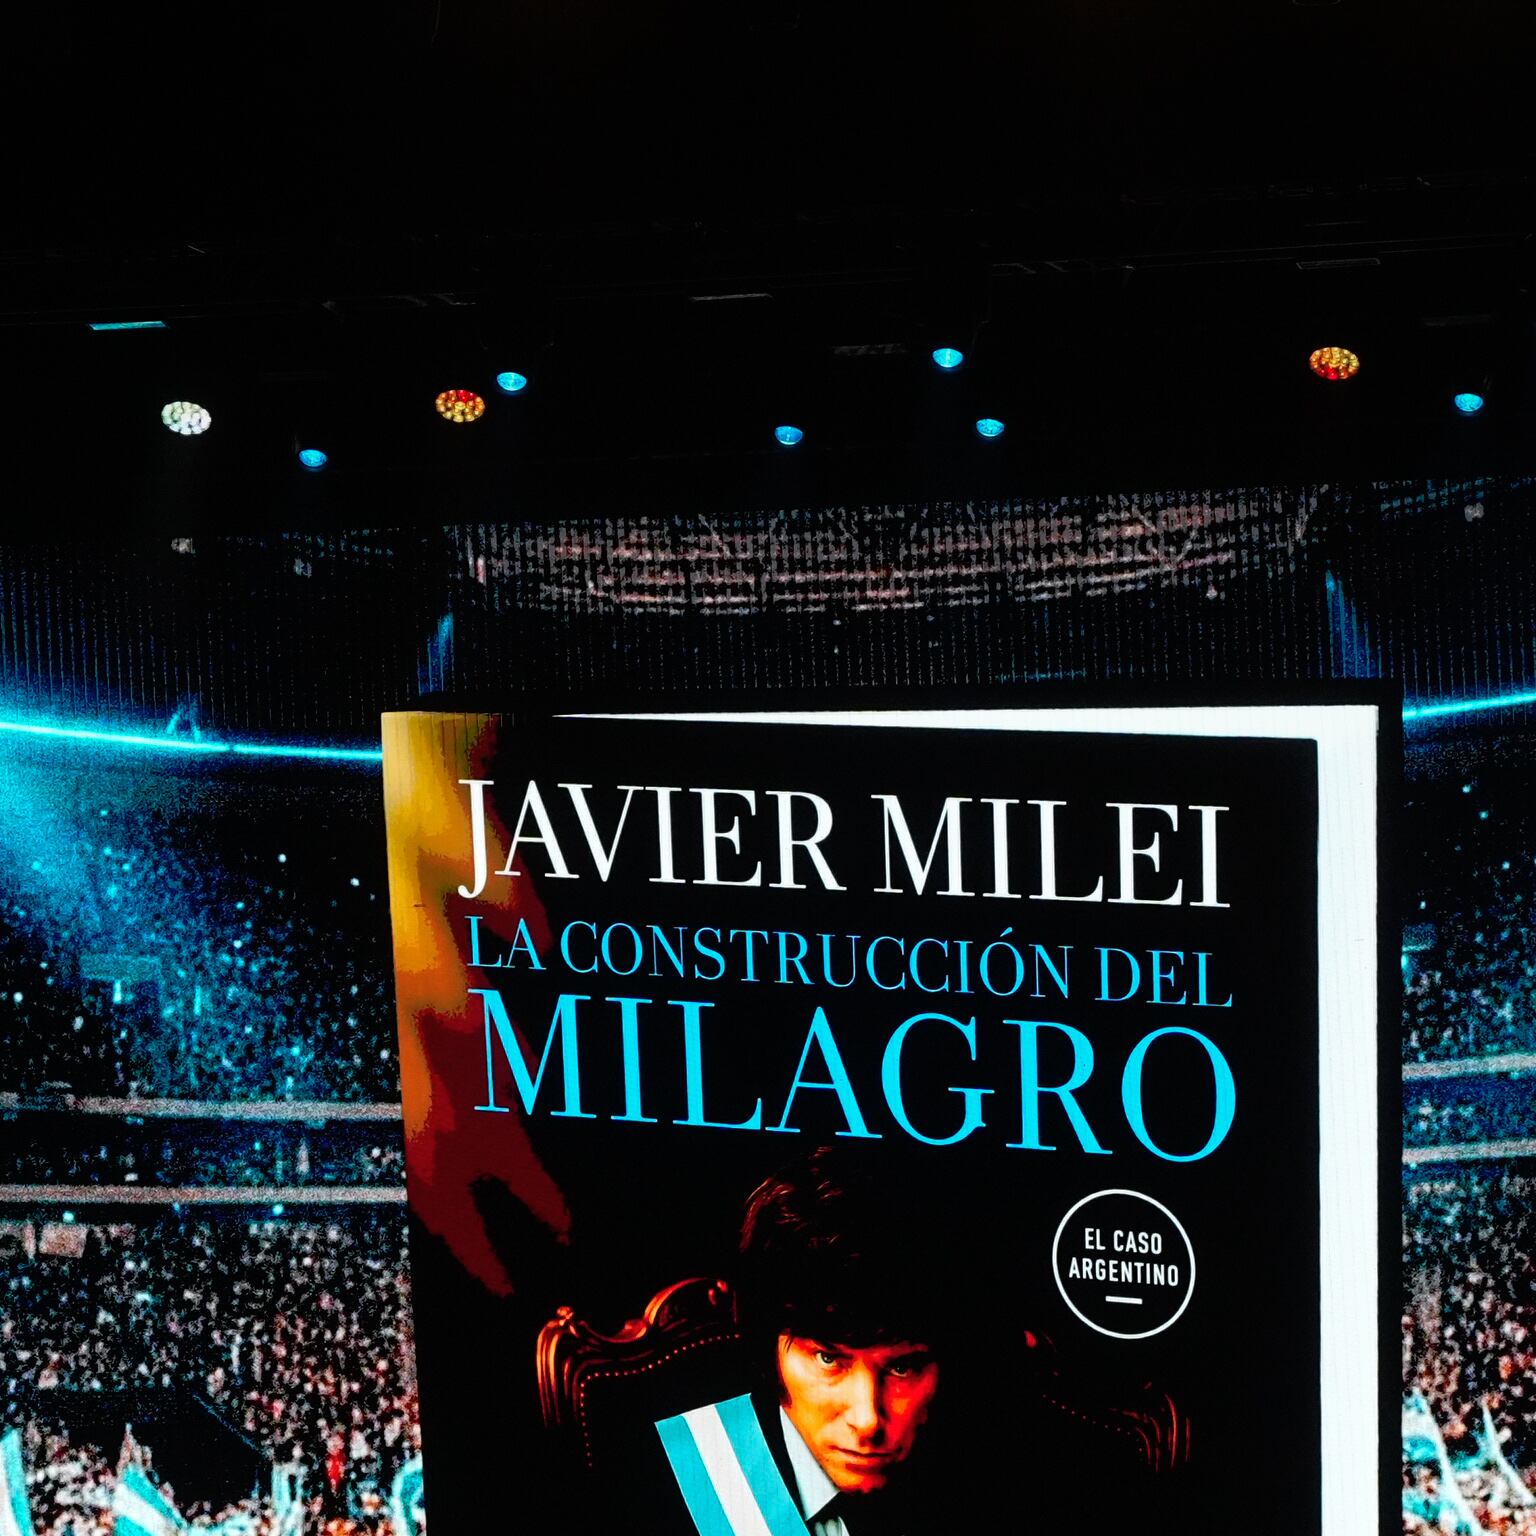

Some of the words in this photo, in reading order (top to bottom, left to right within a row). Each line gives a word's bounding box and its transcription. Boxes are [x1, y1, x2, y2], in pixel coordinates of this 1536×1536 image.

[457, 778, 849, 899] JAVIER
[870, 794, 1231, 908] MILEI
[464, 915, 546, 971] LA
[560, 920, 1074, 999] CONSTRUCCIÓN
[1094, 947, 1234, 1008] DEL
[468, 988, 1237, 1163] MILAGRO
[1068, 1256, 1179, 1287] ARGENTINO
[1084, 1227, 1106, 1250] EL
[1113, 1229, 1162, 1255] CASO
